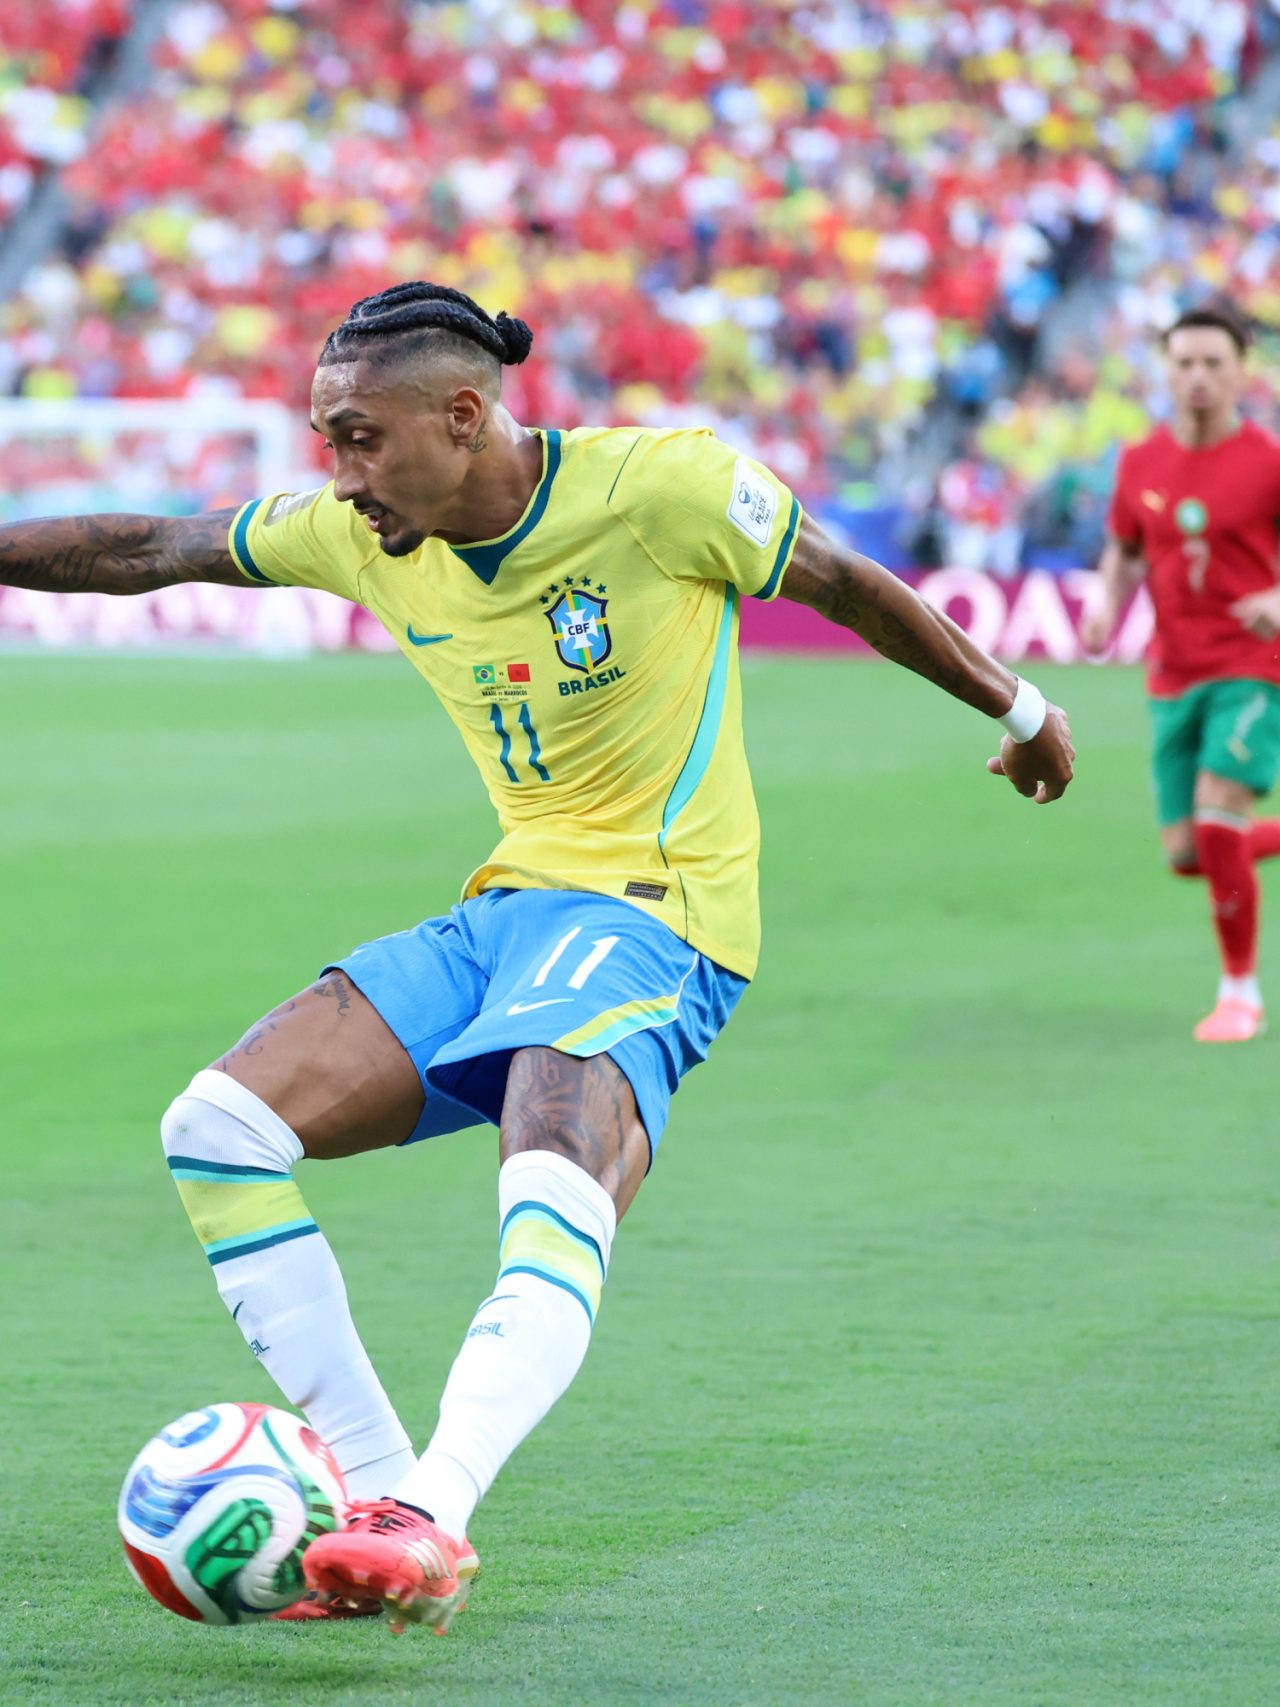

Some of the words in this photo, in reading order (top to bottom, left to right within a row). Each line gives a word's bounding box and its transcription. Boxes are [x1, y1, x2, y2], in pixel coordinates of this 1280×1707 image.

[1182, 537, 1210, 593] 7
[567, 622, 590, 636] CBF
[558, 666, 627, 696] BRASIL
[489, 703, 552, 783] 11
[531, 926, 621, 990] 11
